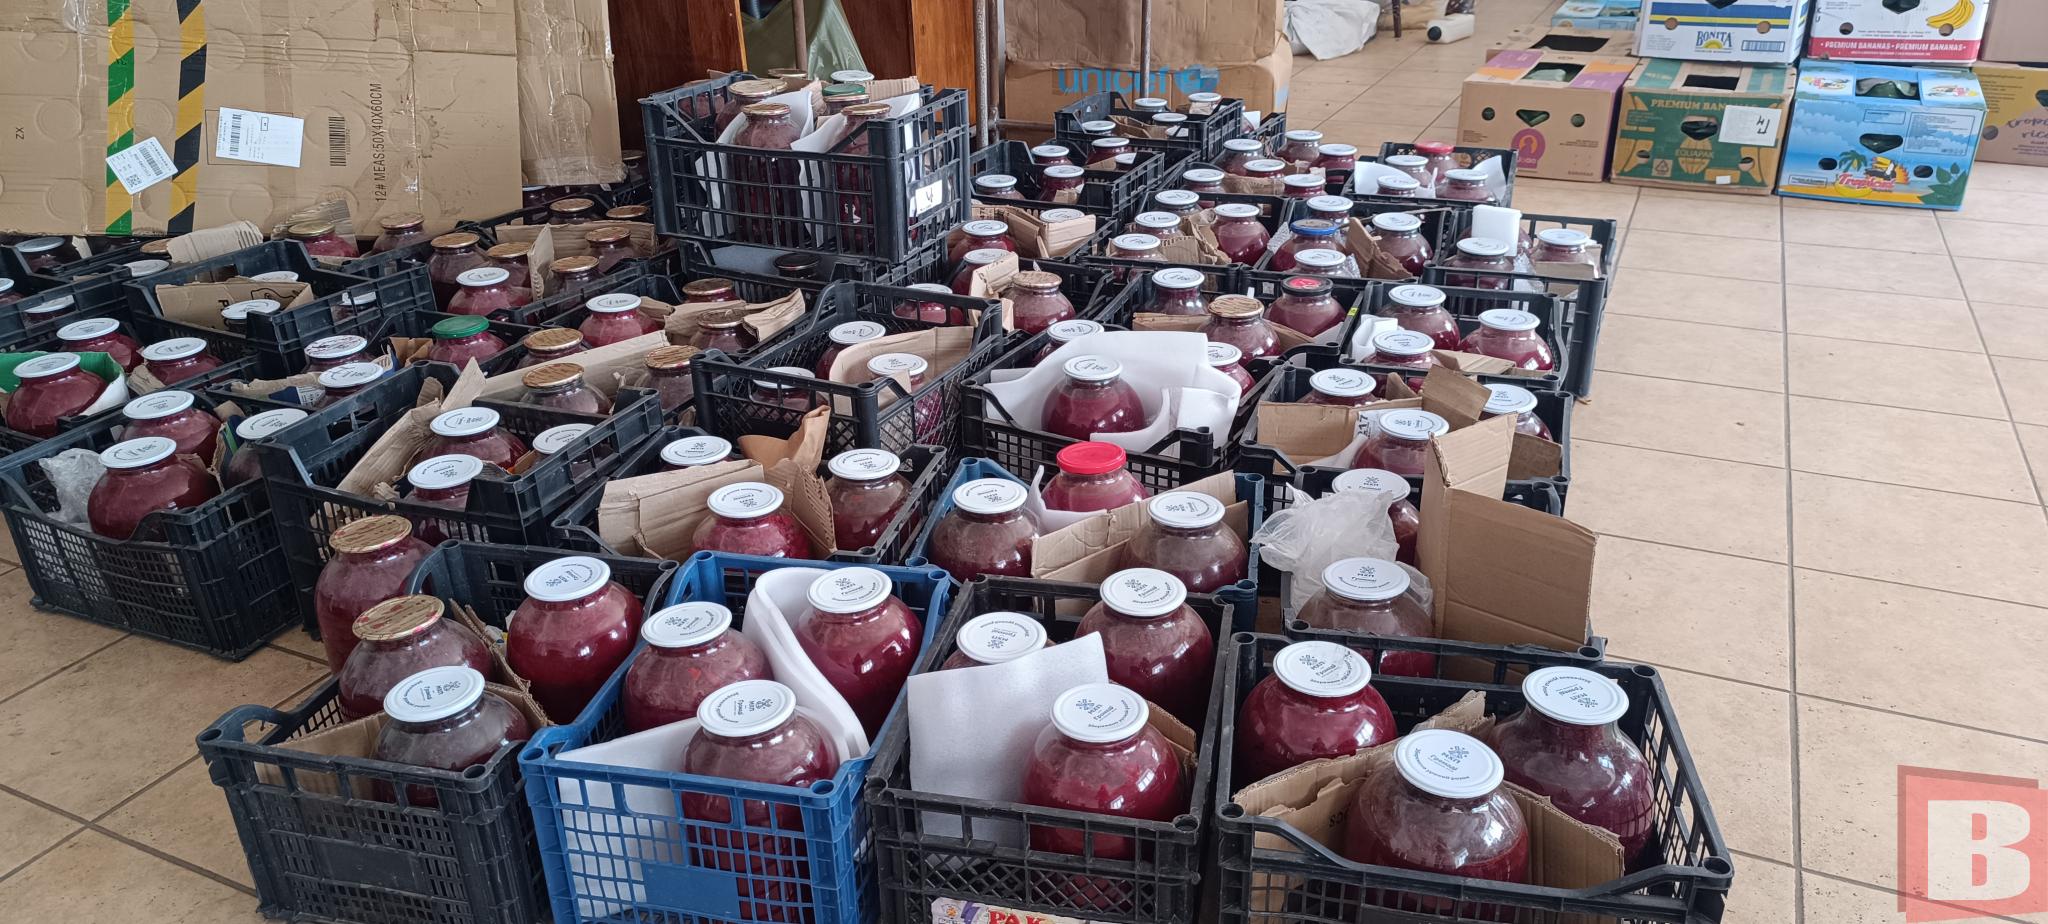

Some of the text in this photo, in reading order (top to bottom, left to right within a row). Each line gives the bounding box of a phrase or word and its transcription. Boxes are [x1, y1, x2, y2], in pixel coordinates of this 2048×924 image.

[1696, 31, 1732, 48] BONITA
[1825, 41, 1858, 49] PREMIUM
[1858, 42, 1891, 50] BANANAS
[1895, 43, 1930, 51] PREMIUM
[1058, 64, 1170, 94] unicef
[1651, 99, 1700, 110] PREMIUM
[16, 127, 25, 140] ZX
[369, 83, 387, 202] 12# MEAS:50X40X60CM
[1839, 172, 1896, 189] Tropical
